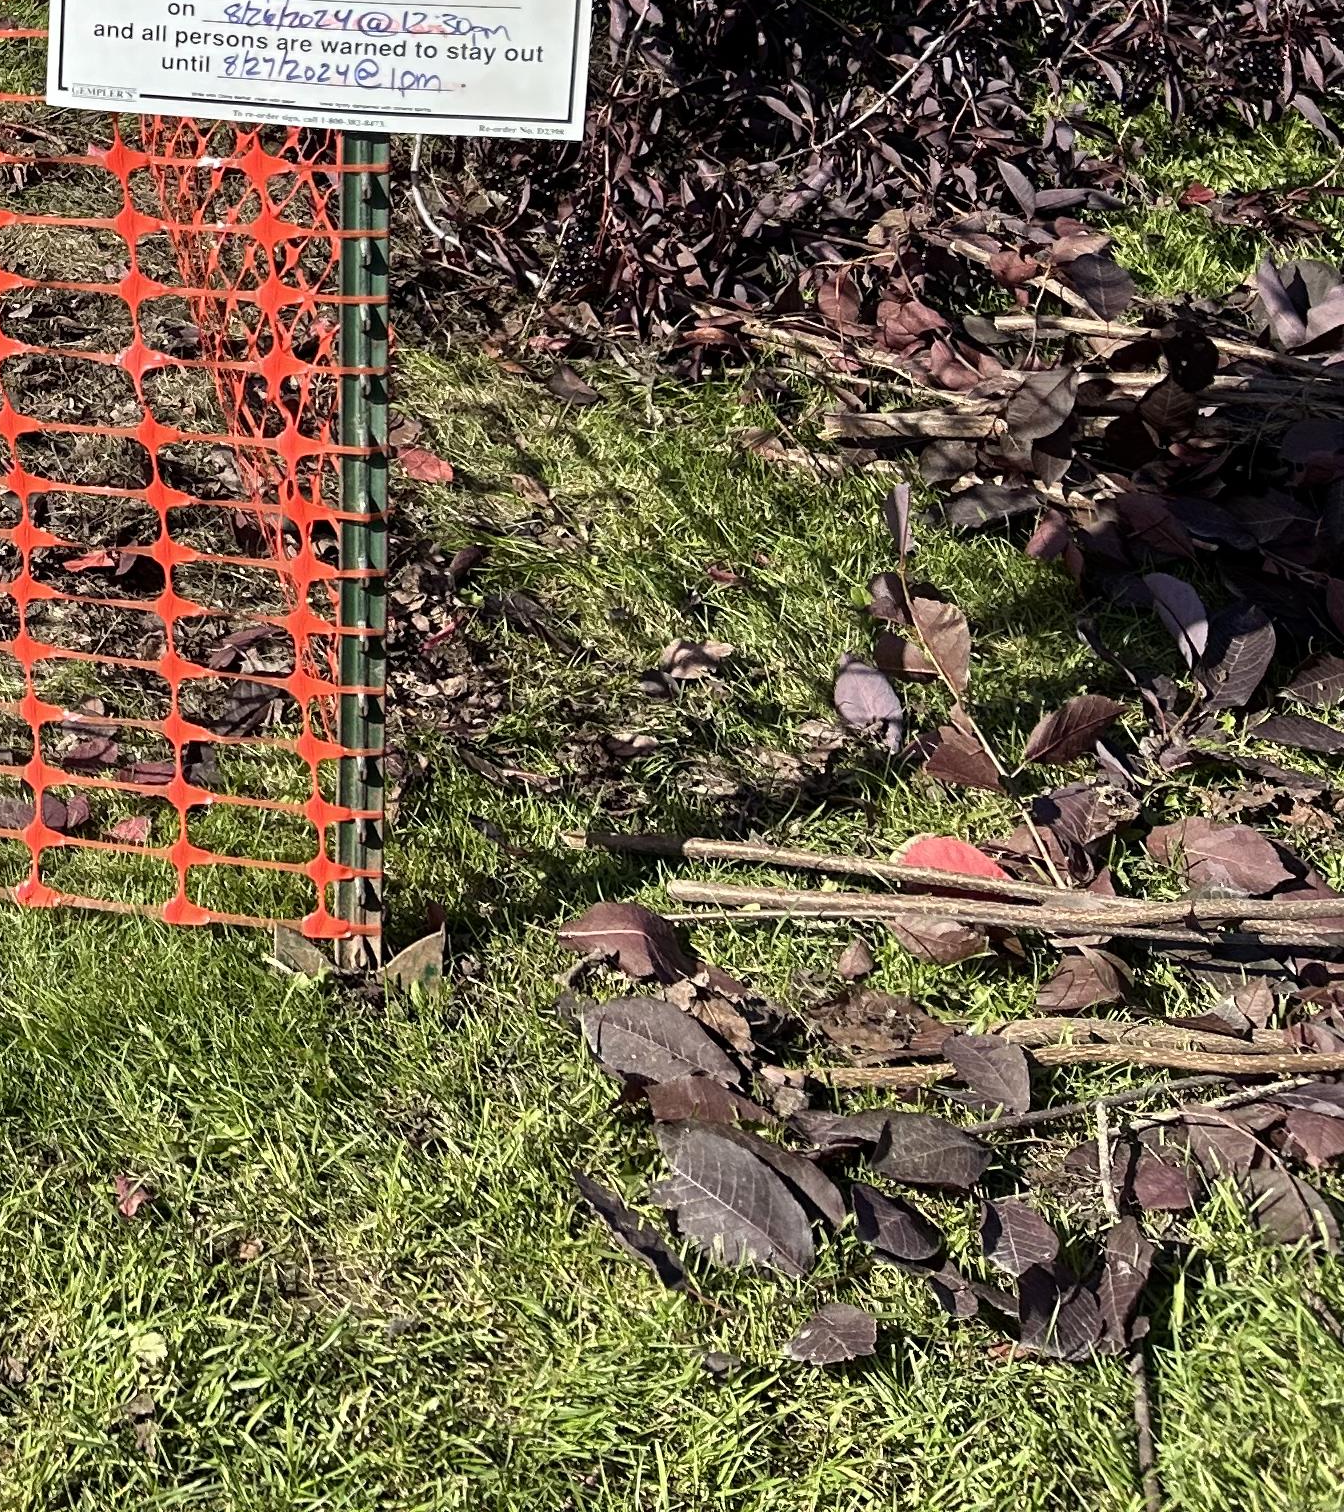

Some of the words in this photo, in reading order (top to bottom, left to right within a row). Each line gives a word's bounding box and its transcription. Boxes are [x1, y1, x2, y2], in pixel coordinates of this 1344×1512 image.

[167, 2, 195, 17] on
[93, 22, 134, 39] and
[141, 24, 167, 42] all
[175, 29, 269, 50] persons
[276, 36, 313, 53] are
[321, 40, 408, 57] warned
[415, 41, 438, 59] to
[446, 43, 497, 65] stay
[505, 46, 544, 63] out
[162, 55, 210, 73] until
[232, 109, 243, 117] To
[478, 124, 517, 133] Re-order
